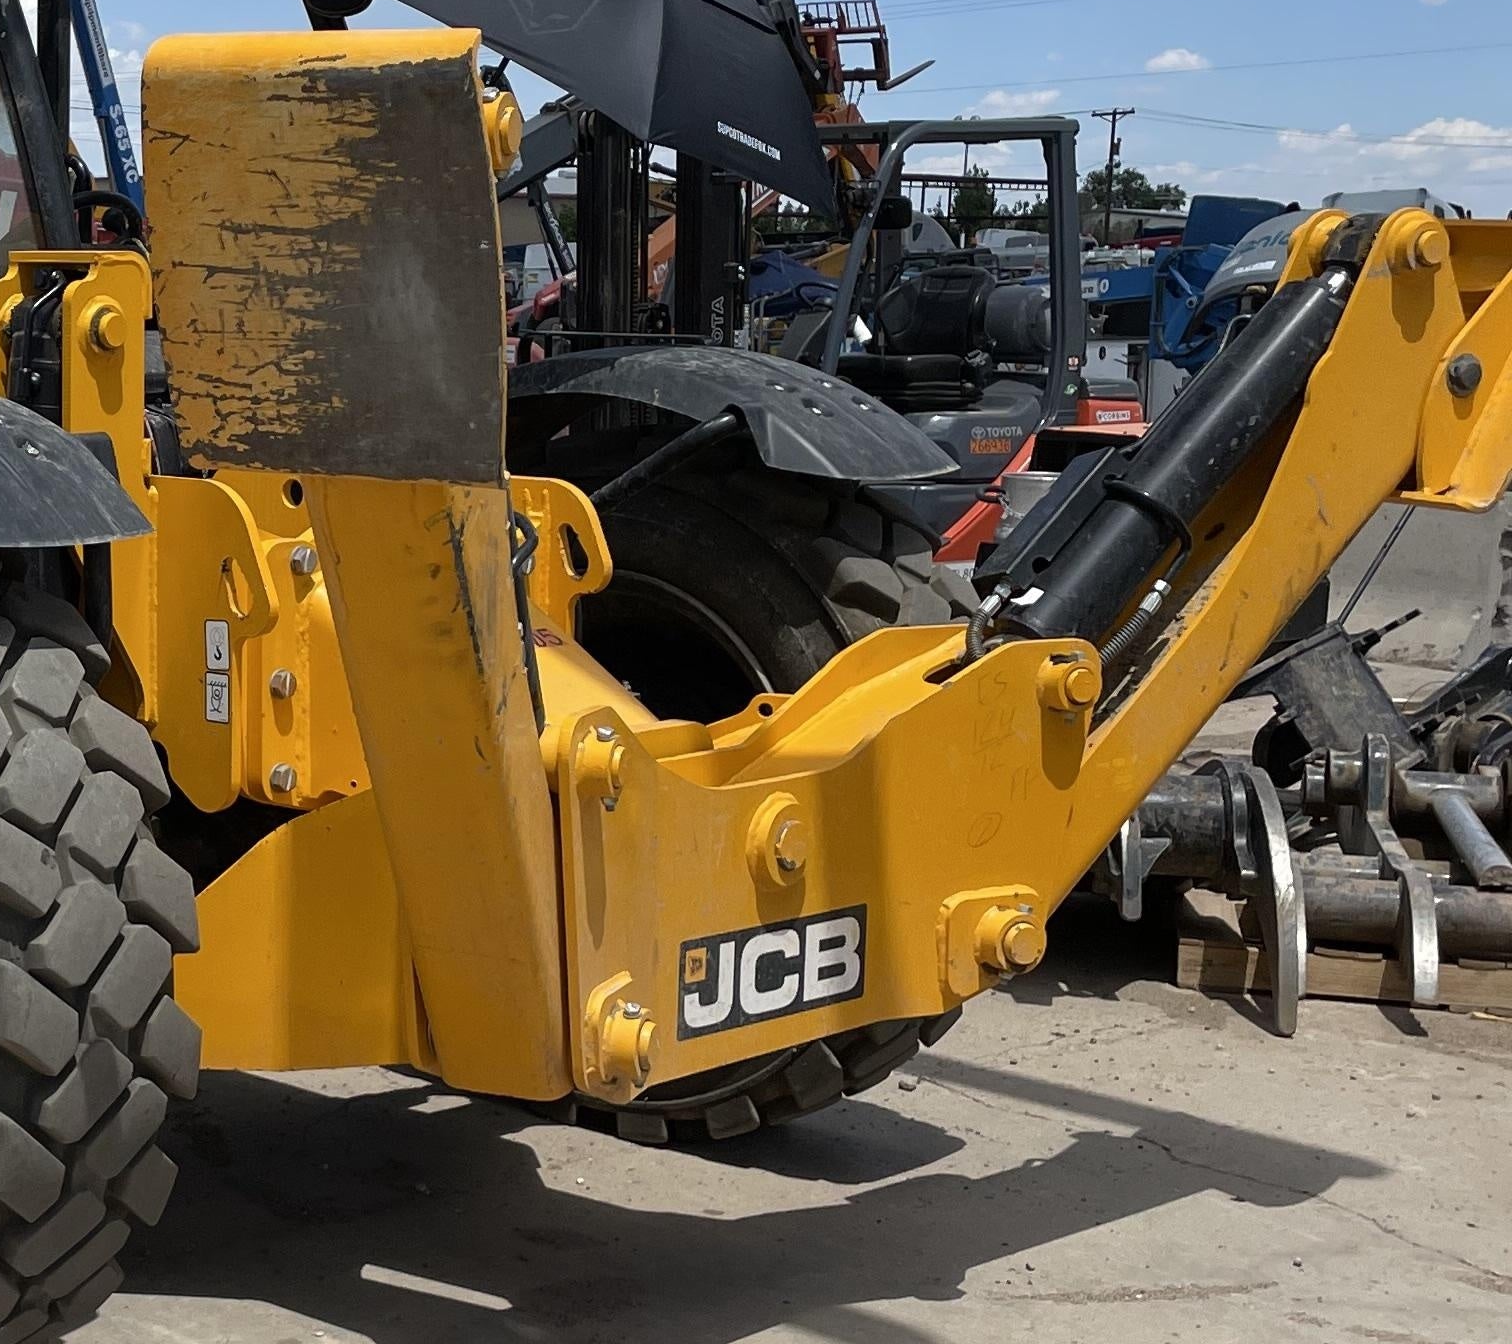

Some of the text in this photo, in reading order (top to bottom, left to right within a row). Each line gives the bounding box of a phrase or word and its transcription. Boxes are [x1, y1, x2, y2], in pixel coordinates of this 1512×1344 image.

[109, 103, 139, 184] S-65 XC
[711, 296, 724, 344] OTA
[987, 426, 1023, 438] TOYOTA
[683, 916, 861, 1028] JCB
